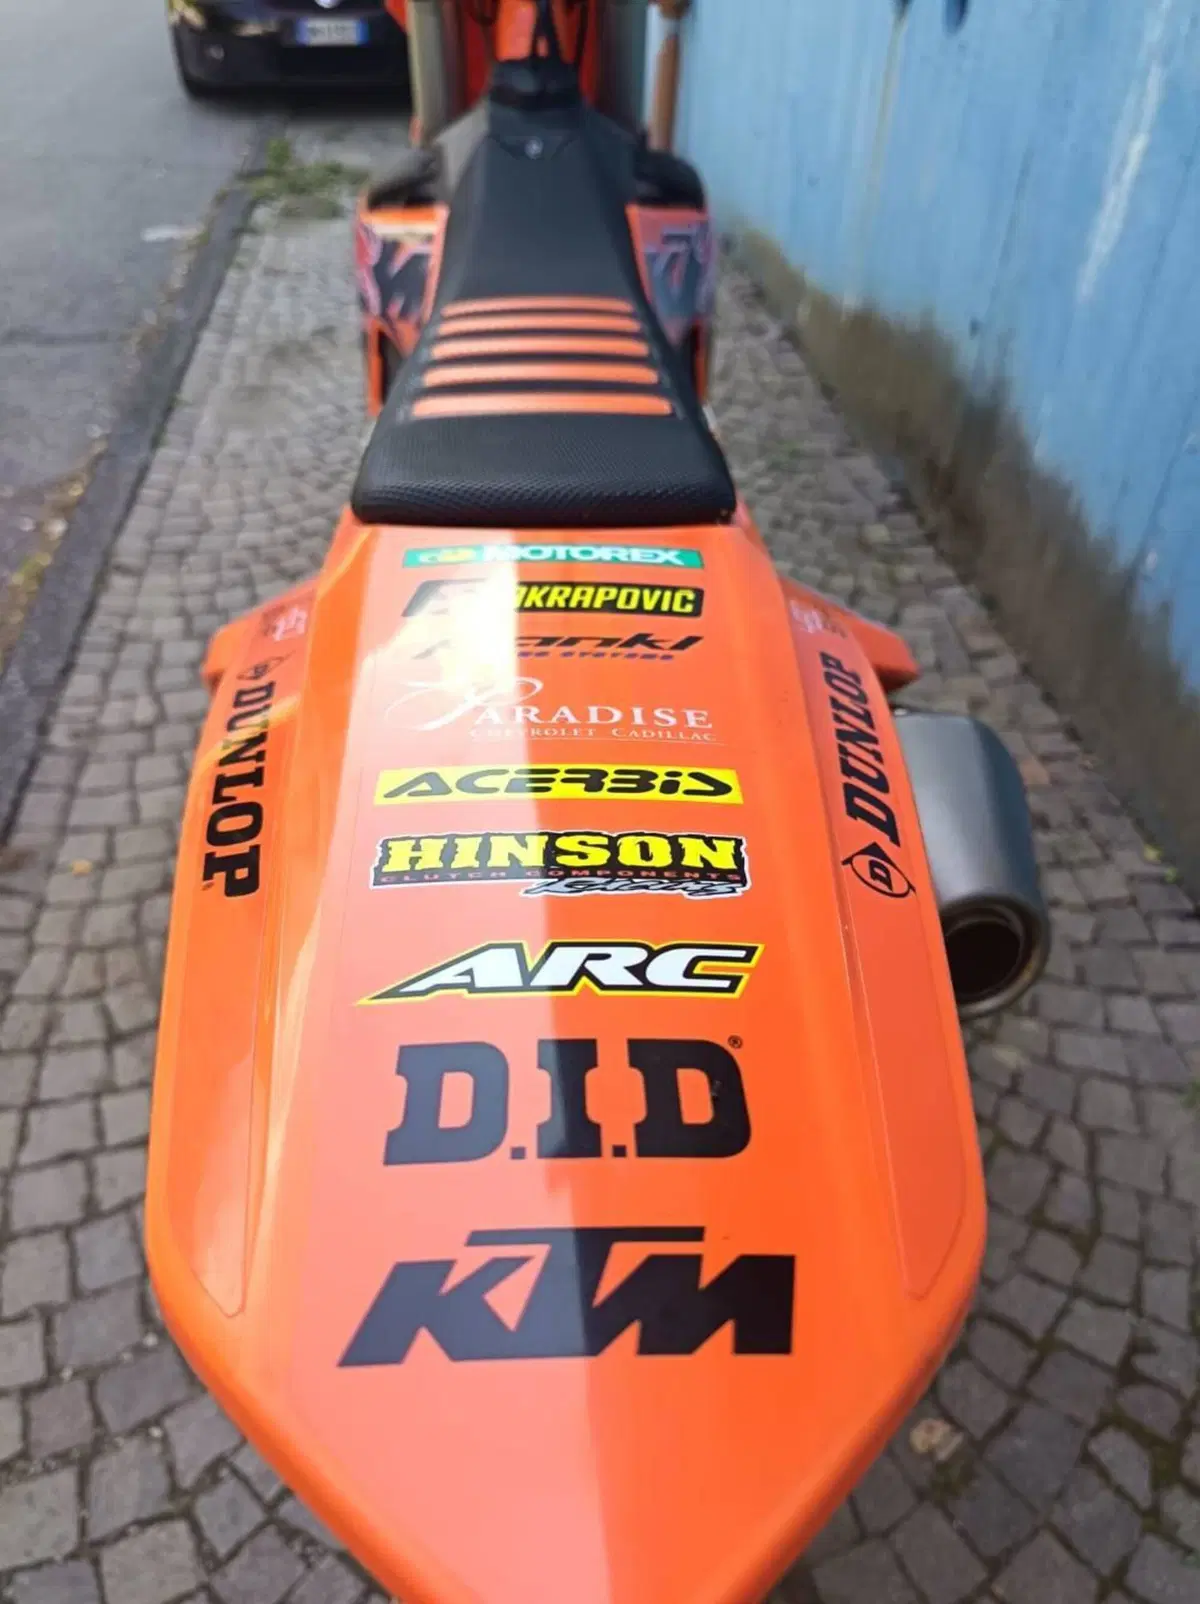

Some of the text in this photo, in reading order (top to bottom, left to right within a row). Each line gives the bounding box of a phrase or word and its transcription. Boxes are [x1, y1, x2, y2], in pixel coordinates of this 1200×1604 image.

[202, 681, 276, 897] DUNLOP
[820, 652, 901, 848] DUNLOP
[381, 869, 741, 883] CLUTCH COMPONENTS
[382, 832, 739, 872] HINSON
[364, 941, 761, 1001] ARC
[384, 1038, 751, 1166] D.I.D
[336, 1226, 796, 1367] KTM
